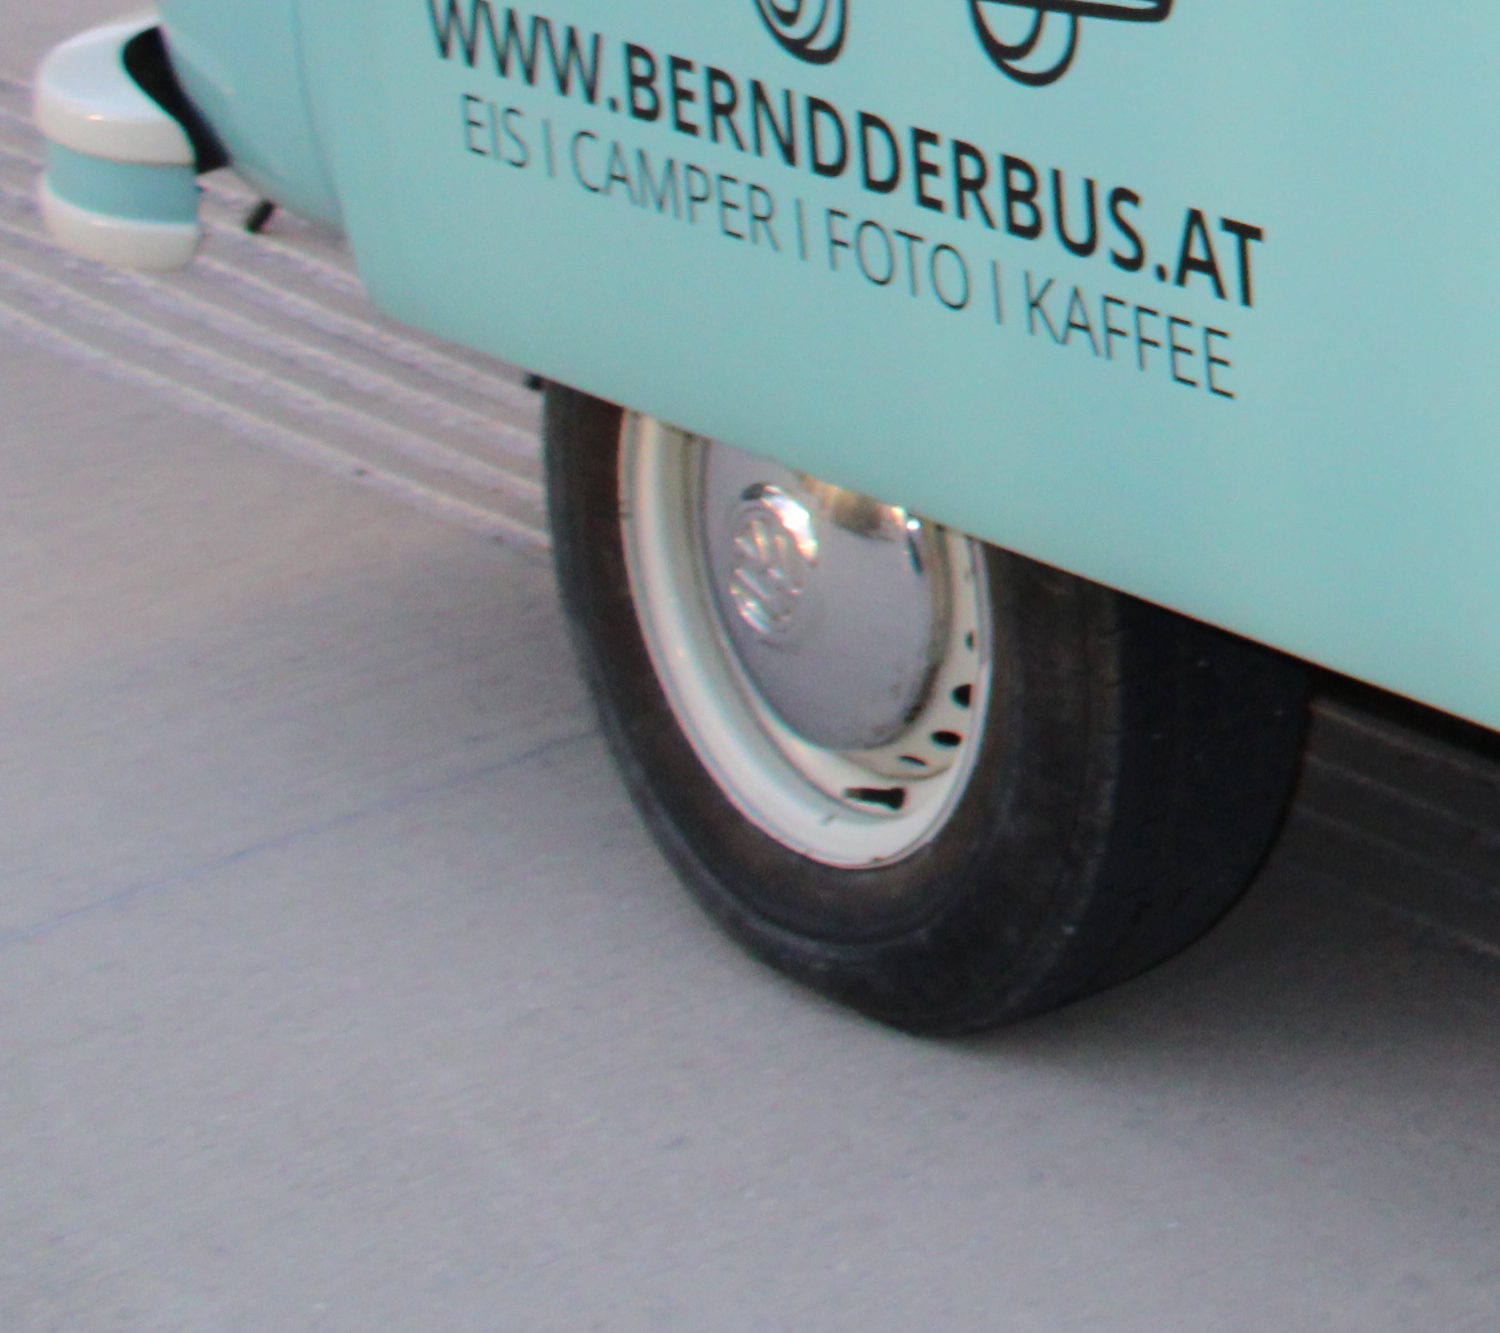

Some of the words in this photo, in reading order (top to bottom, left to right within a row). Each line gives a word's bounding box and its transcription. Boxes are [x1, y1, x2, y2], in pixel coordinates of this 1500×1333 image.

[461, 95, 529, 169] EIS
[572, 131, 781, 251] CAMPER
[827, 209, 971, 310] FOTO
[1024, 270, 1236, 399] KAFFEE
